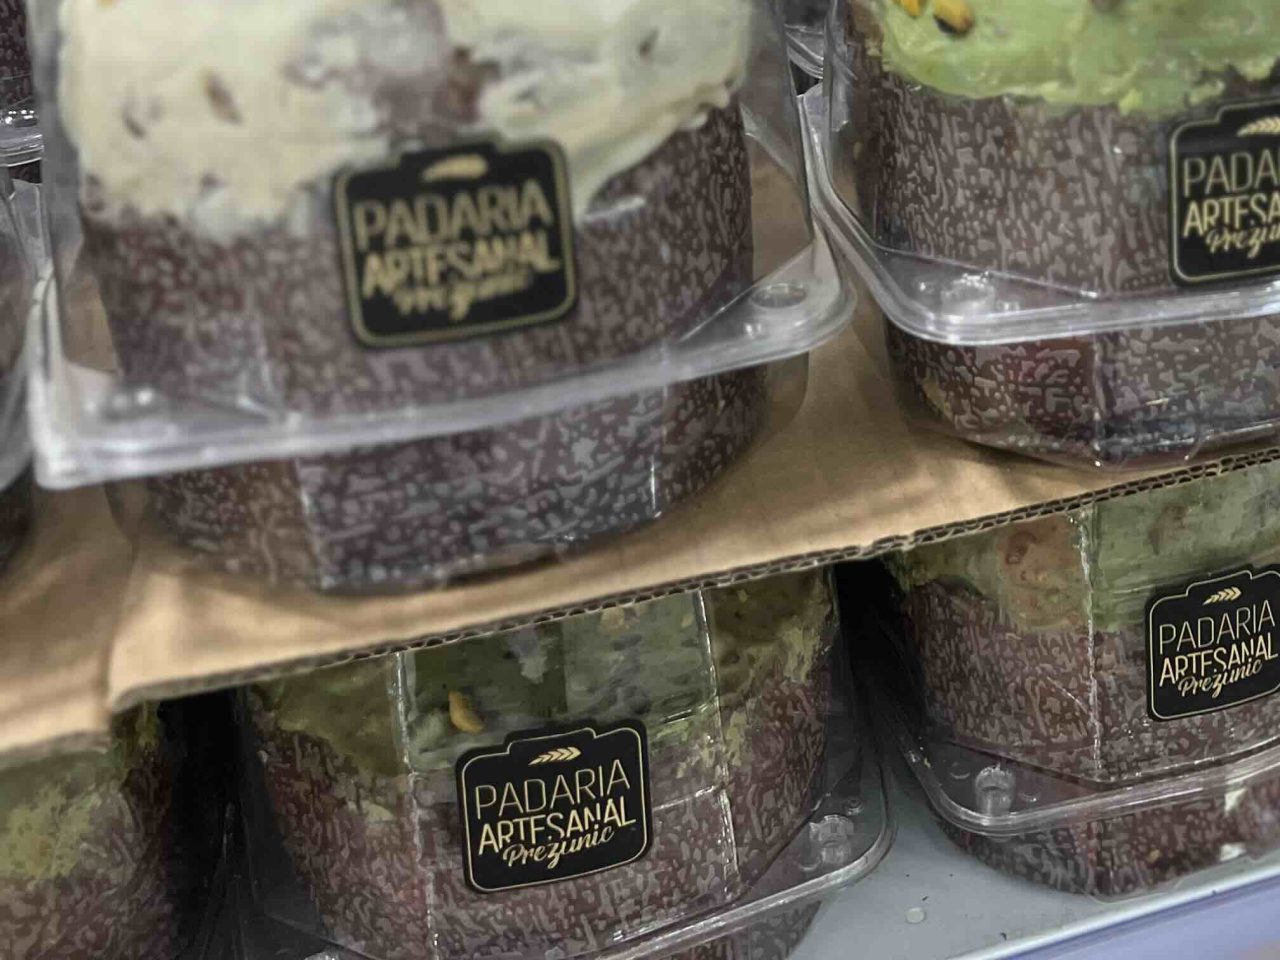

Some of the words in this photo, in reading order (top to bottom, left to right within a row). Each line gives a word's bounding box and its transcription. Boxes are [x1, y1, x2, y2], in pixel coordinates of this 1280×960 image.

[354, 178, 554, 251] PADARIA
[1159, 600, 1275, 655] PADARIA
[1159, 632, 1279, 687] ARTESANAL
[1178, 658, 1263, 699] Prezunic
[475, 759, 631, 820] PADARIA
[478, 796, 636, 856] ARTESANAL
[502, 824, 615, 869] Prezunic
